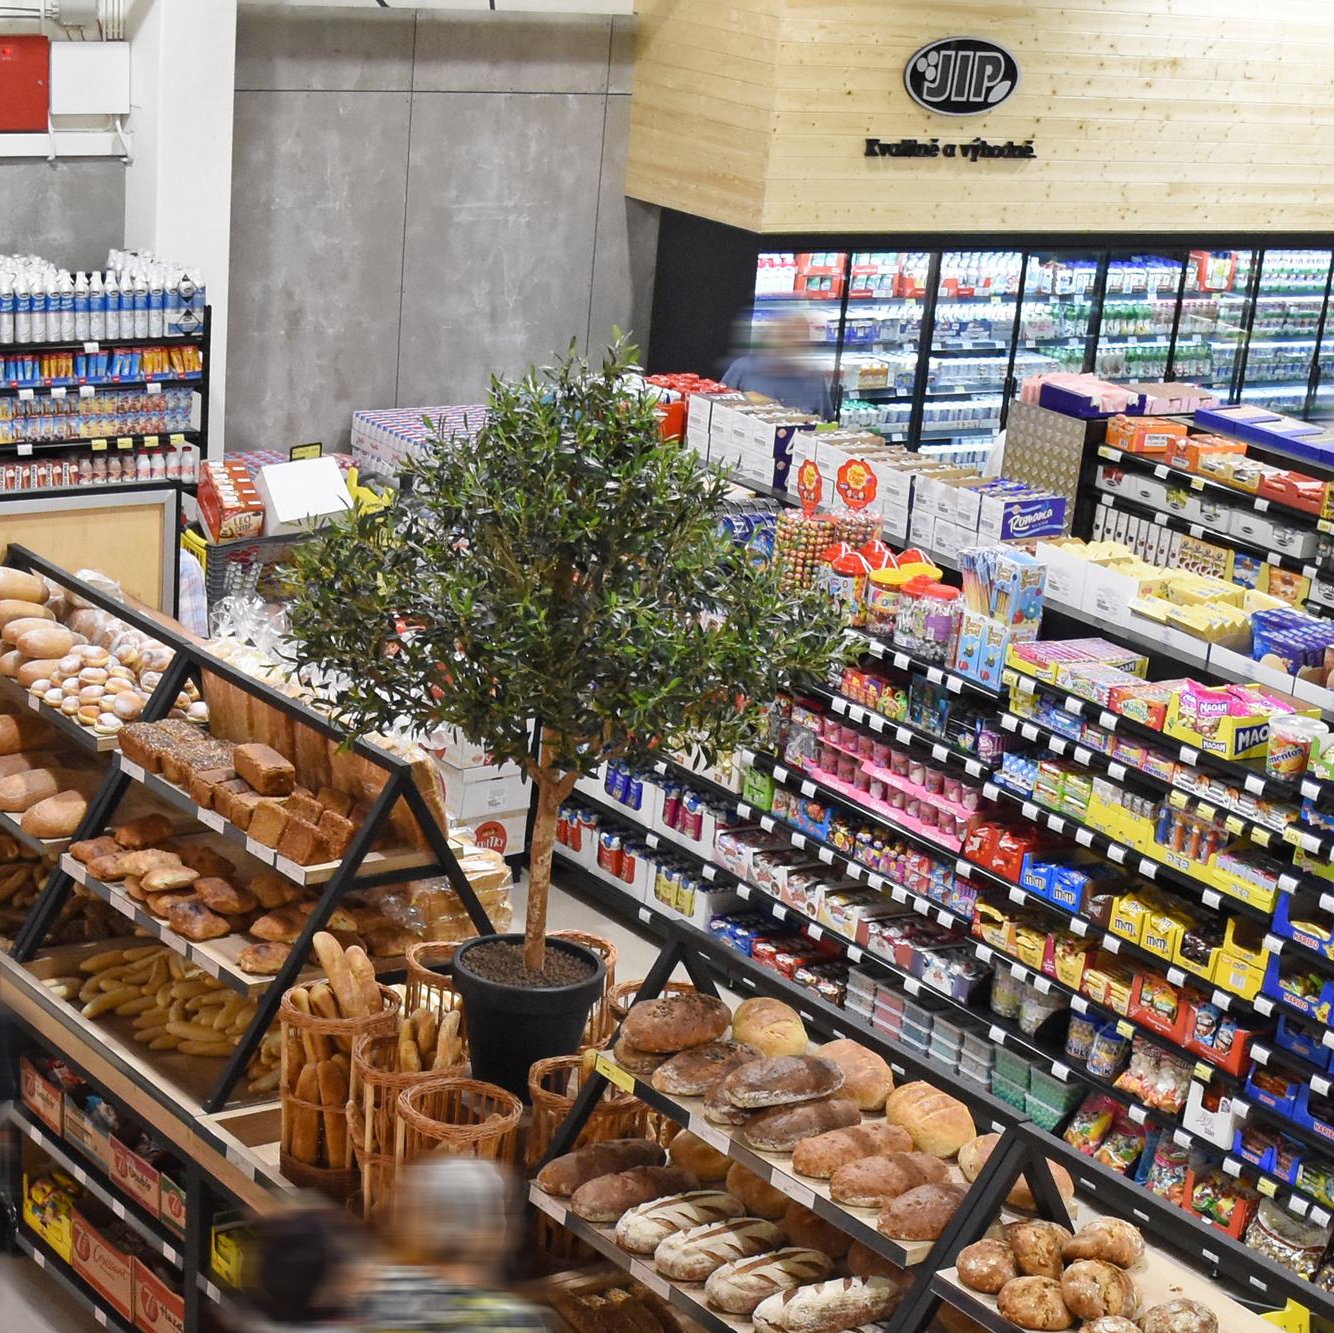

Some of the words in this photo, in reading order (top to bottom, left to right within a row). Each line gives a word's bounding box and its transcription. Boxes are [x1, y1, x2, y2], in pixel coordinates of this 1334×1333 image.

[922, 50, 1006, 103] JIP
[942, 144, 957, 157] a
[1113, 751, 1139, 766] mentos
[1143, 765, 1169, 780] mentos
[1292, 931, 1319, 950] HARIBO
[1283, 992, 1308, 1012] HARIBO
